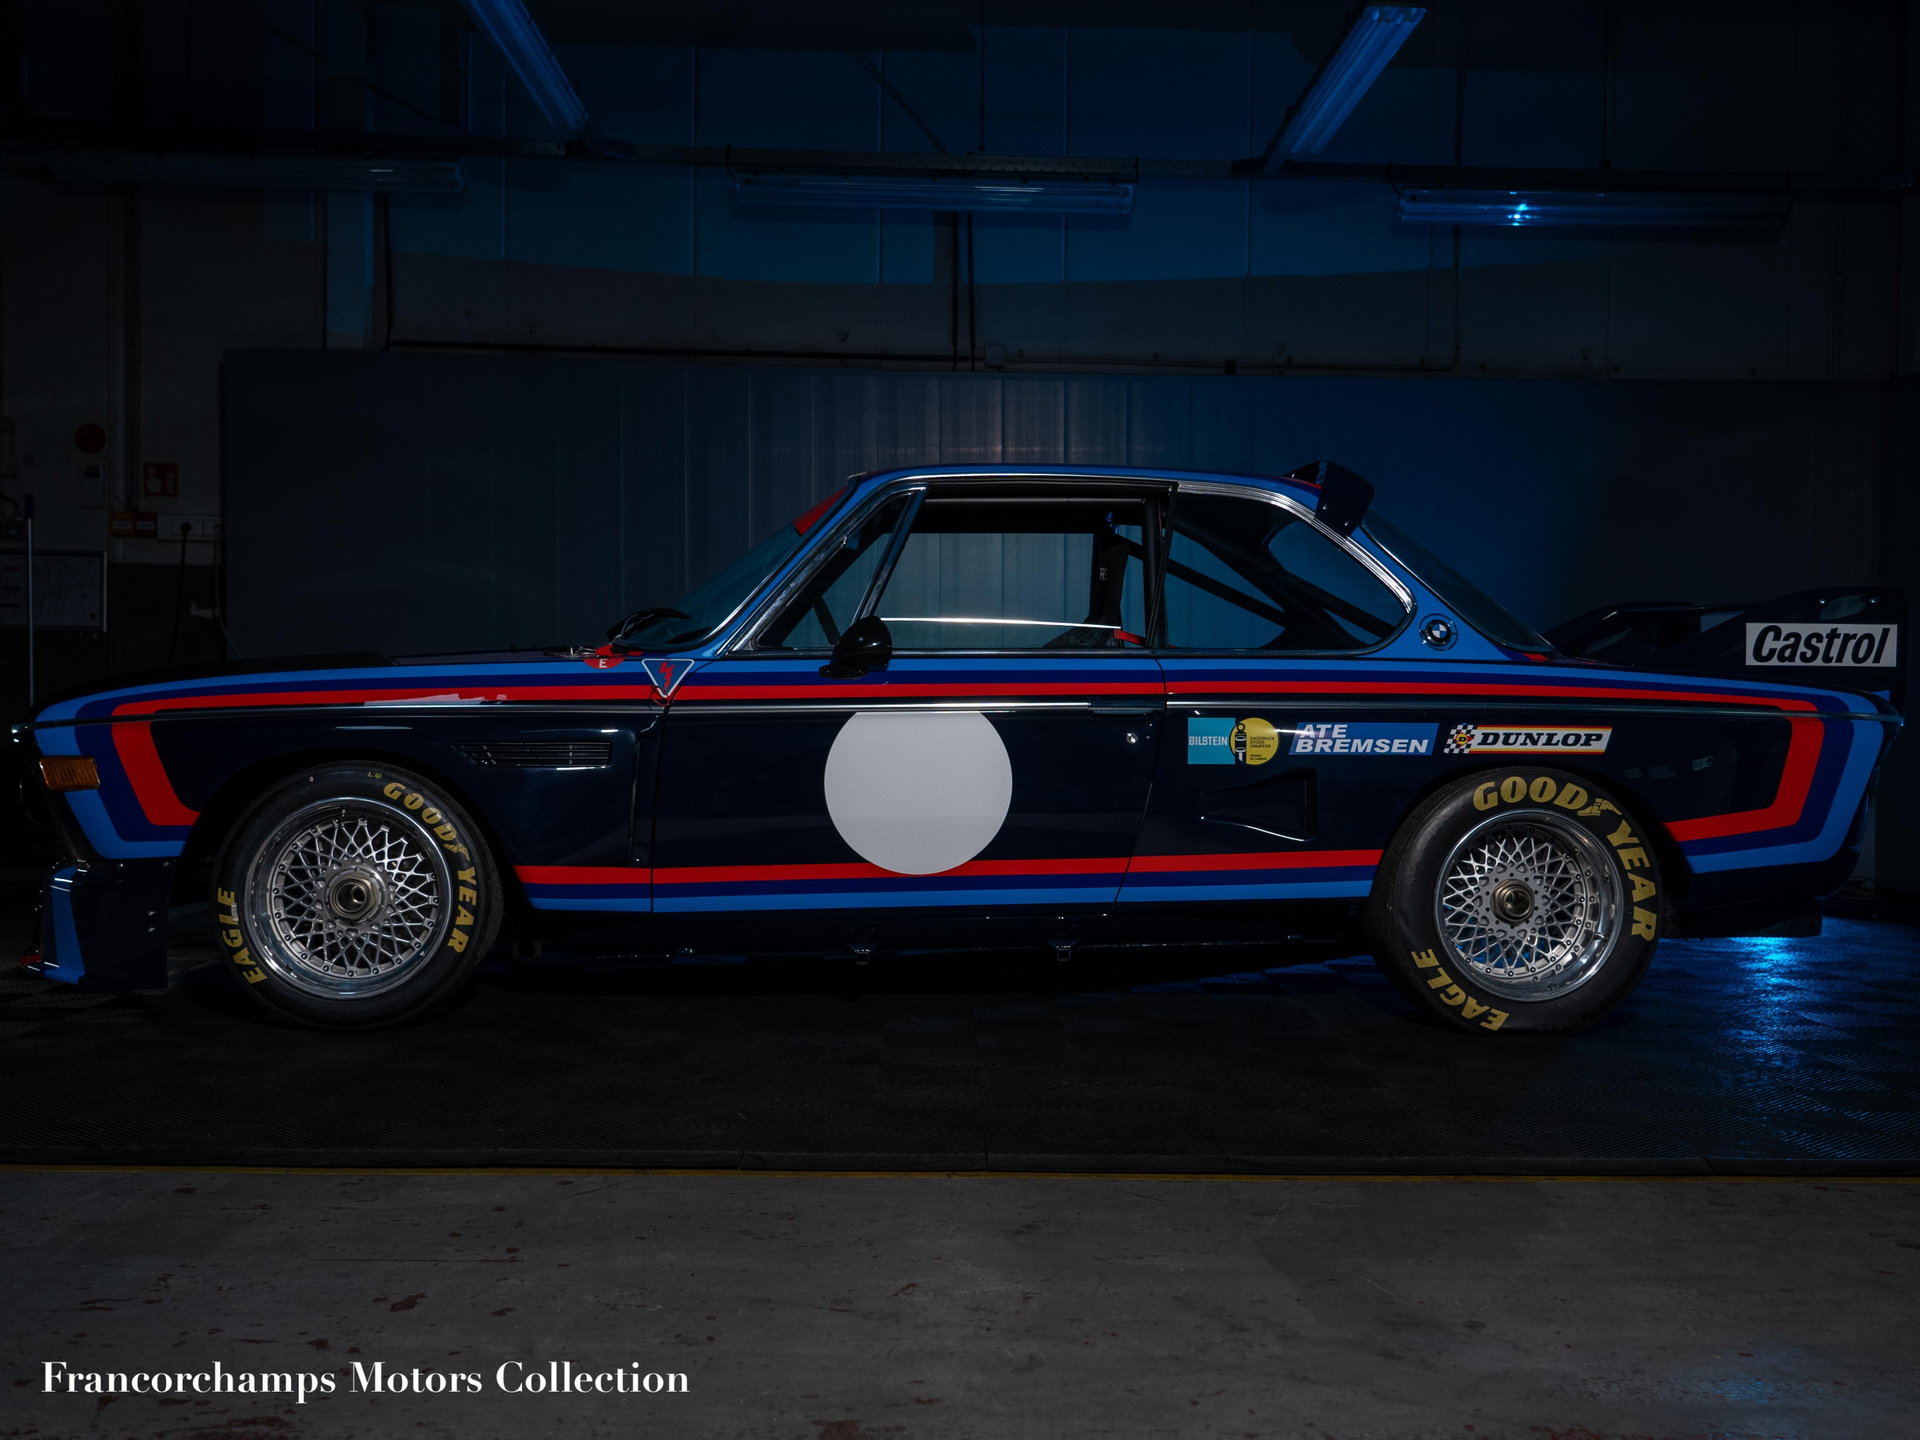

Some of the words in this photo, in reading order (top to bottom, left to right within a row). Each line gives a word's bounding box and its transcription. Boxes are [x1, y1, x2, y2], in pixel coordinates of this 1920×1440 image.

[1752, 624, 1891, 664] Castrol
[599, 658, 609, 669] E
[1188, 735, 1230, 746] BILSTEIN
[1301, 724, 1349, 738] ATE
[1477, 732, 1604, 747] DUNLOP
[1295, 738, 1429, 753] BREMSEN
[383, 782, 457, 843] GOOD
[447, 866, 479, 953] YEAR
[1472, 776, 1589, 812] GOOD
[1606, 819, 1659, 943] YEAR
[217, 887, 269, 985] EAGLE
[1410, 948, 1510, 1032] EAGLE
